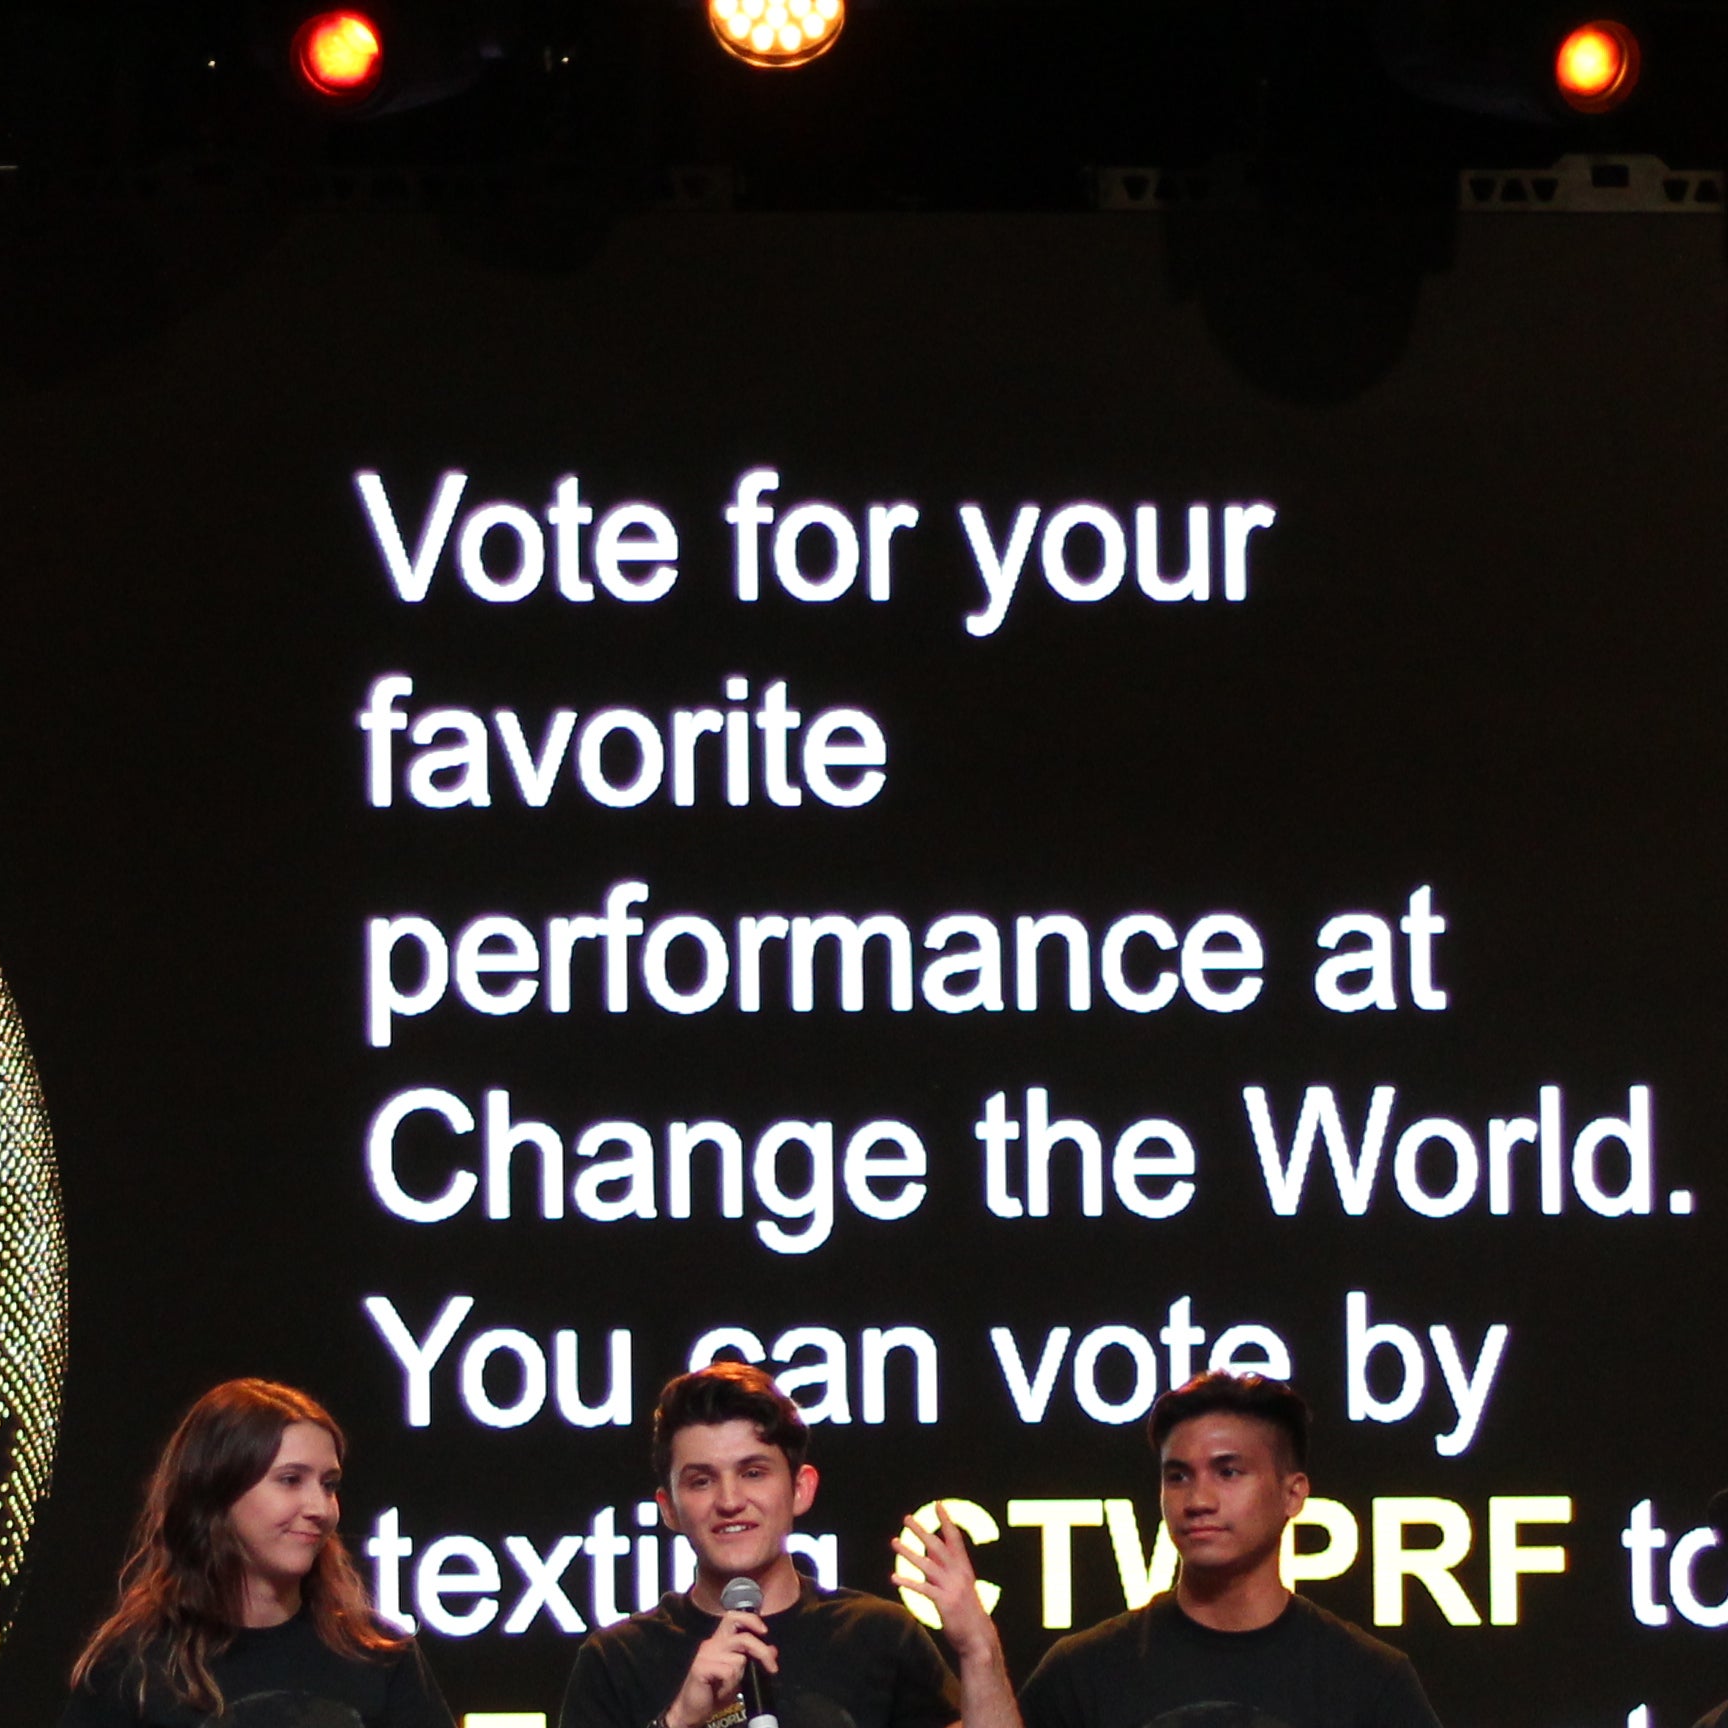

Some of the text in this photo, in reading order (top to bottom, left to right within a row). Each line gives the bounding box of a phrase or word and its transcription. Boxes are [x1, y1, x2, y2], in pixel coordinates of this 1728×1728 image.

[355, 467, 1276, 637] Vote for your
[356, 672, 886, 809] favorite
[365, 880, 1447, 1048] performance at
[364, 1084, 1694, 1254] Change the World.
[363, 1296, 632, 1429] You
[1346, 1291, 1508, 1456] by
